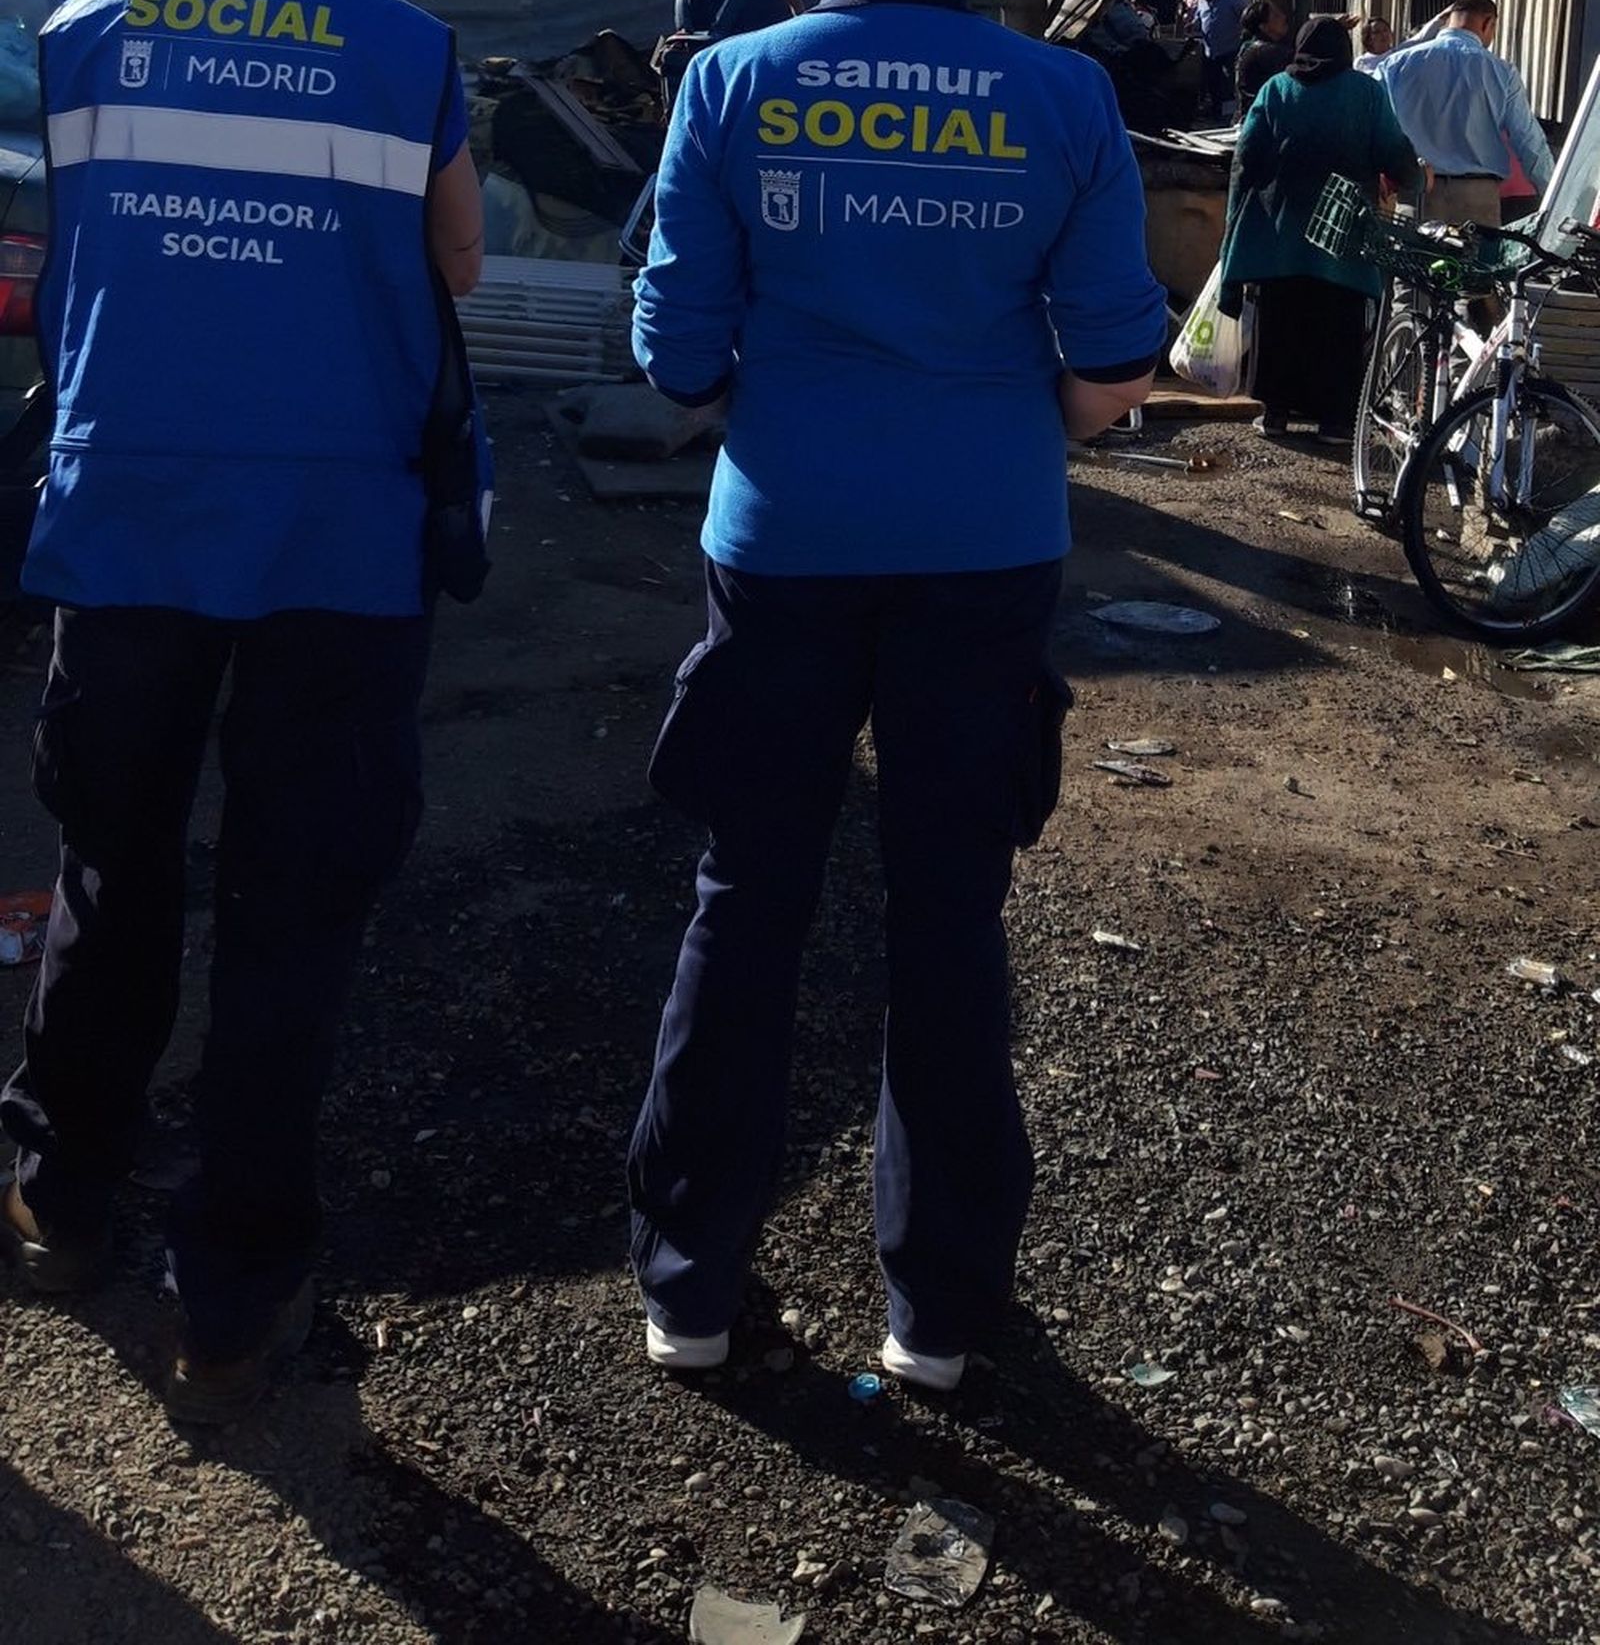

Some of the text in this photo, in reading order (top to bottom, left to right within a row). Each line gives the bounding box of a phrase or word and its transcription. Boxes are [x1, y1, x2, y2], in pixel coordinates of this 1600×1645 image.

[186, 55, 337, 96] MADRID
[795, 58, 1004, 97] samur
[756, 98, 1027, 160] SOCIAL
[109, 191, 314, 230] TRABAJADOR
[843, 192, 1025, 230] MADRID
[161, 232, 284, 265] SOCIAL
